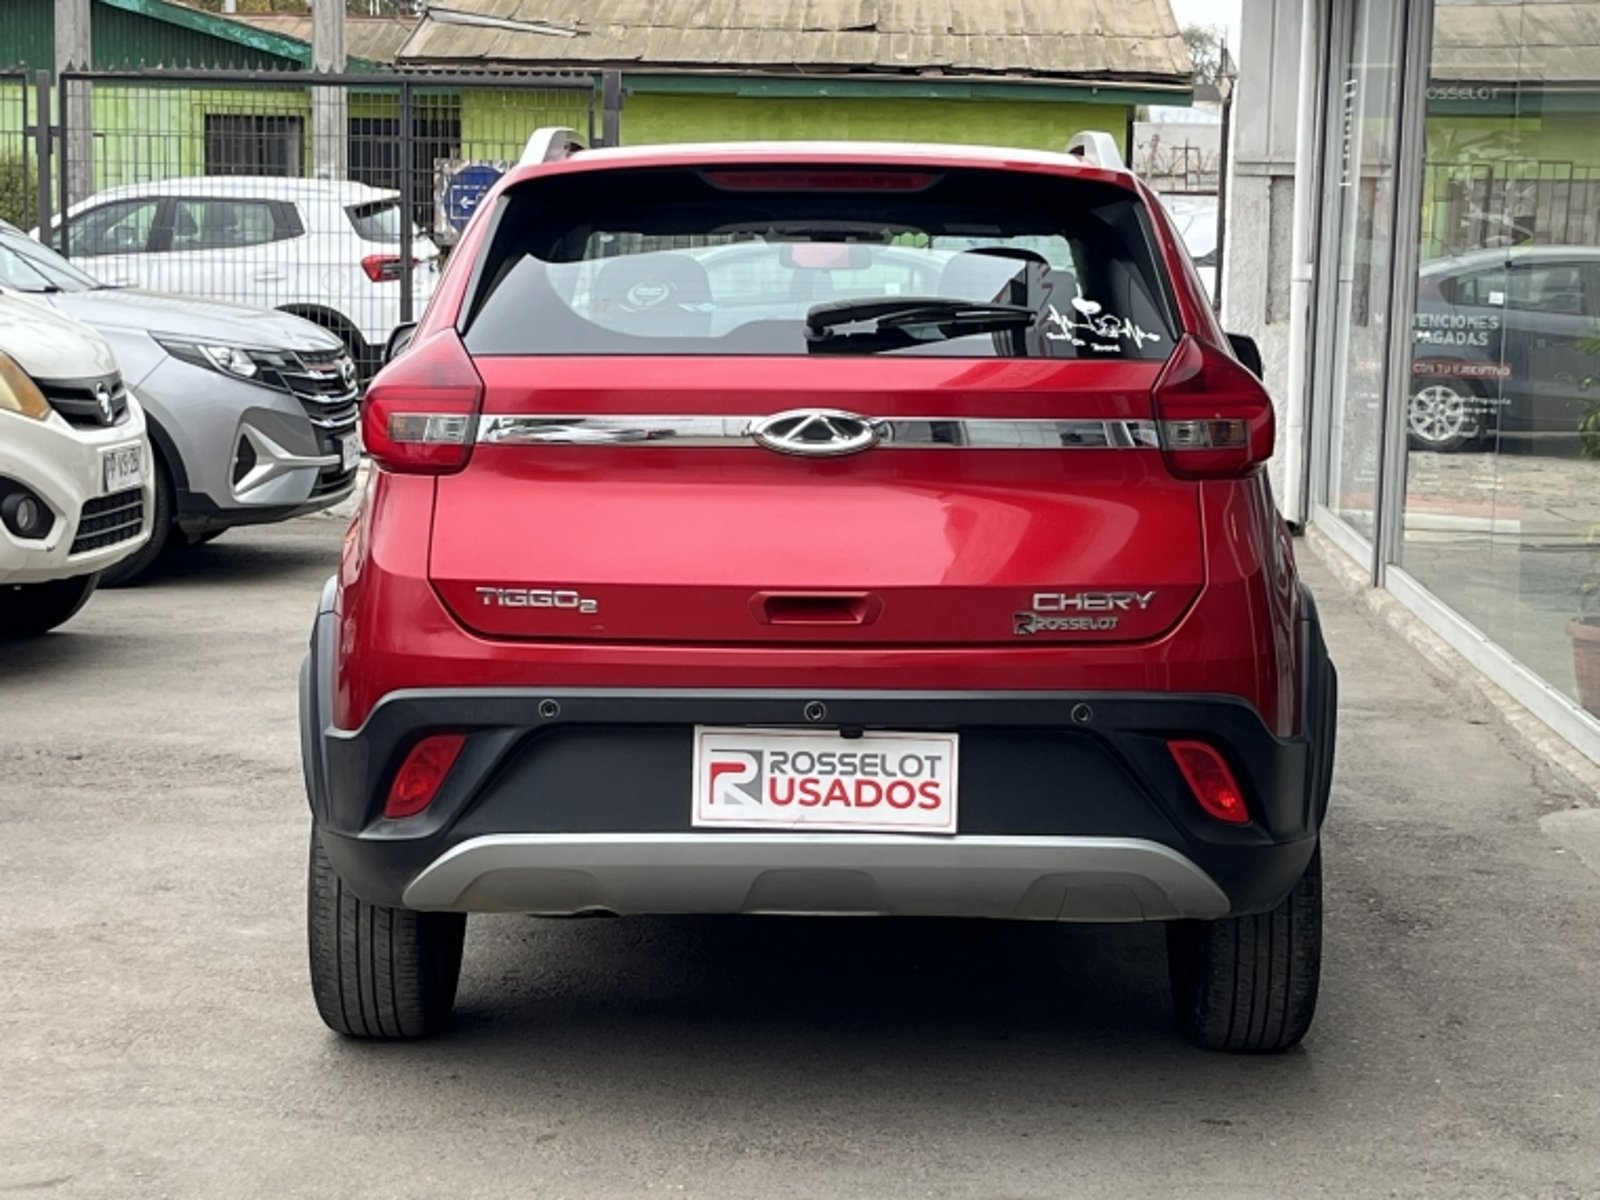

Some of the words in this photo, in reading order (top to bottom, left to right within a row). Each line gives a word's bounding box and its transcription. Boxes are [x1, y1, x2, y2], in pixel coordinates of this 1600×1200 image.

[1032, 591, 1156, 611] CHERY
[1036, 616, 1119, 631] ROSSELOT
[769, 751, 942, 778] ROSSELOT
[769, 777, 942, 810] USADOS
